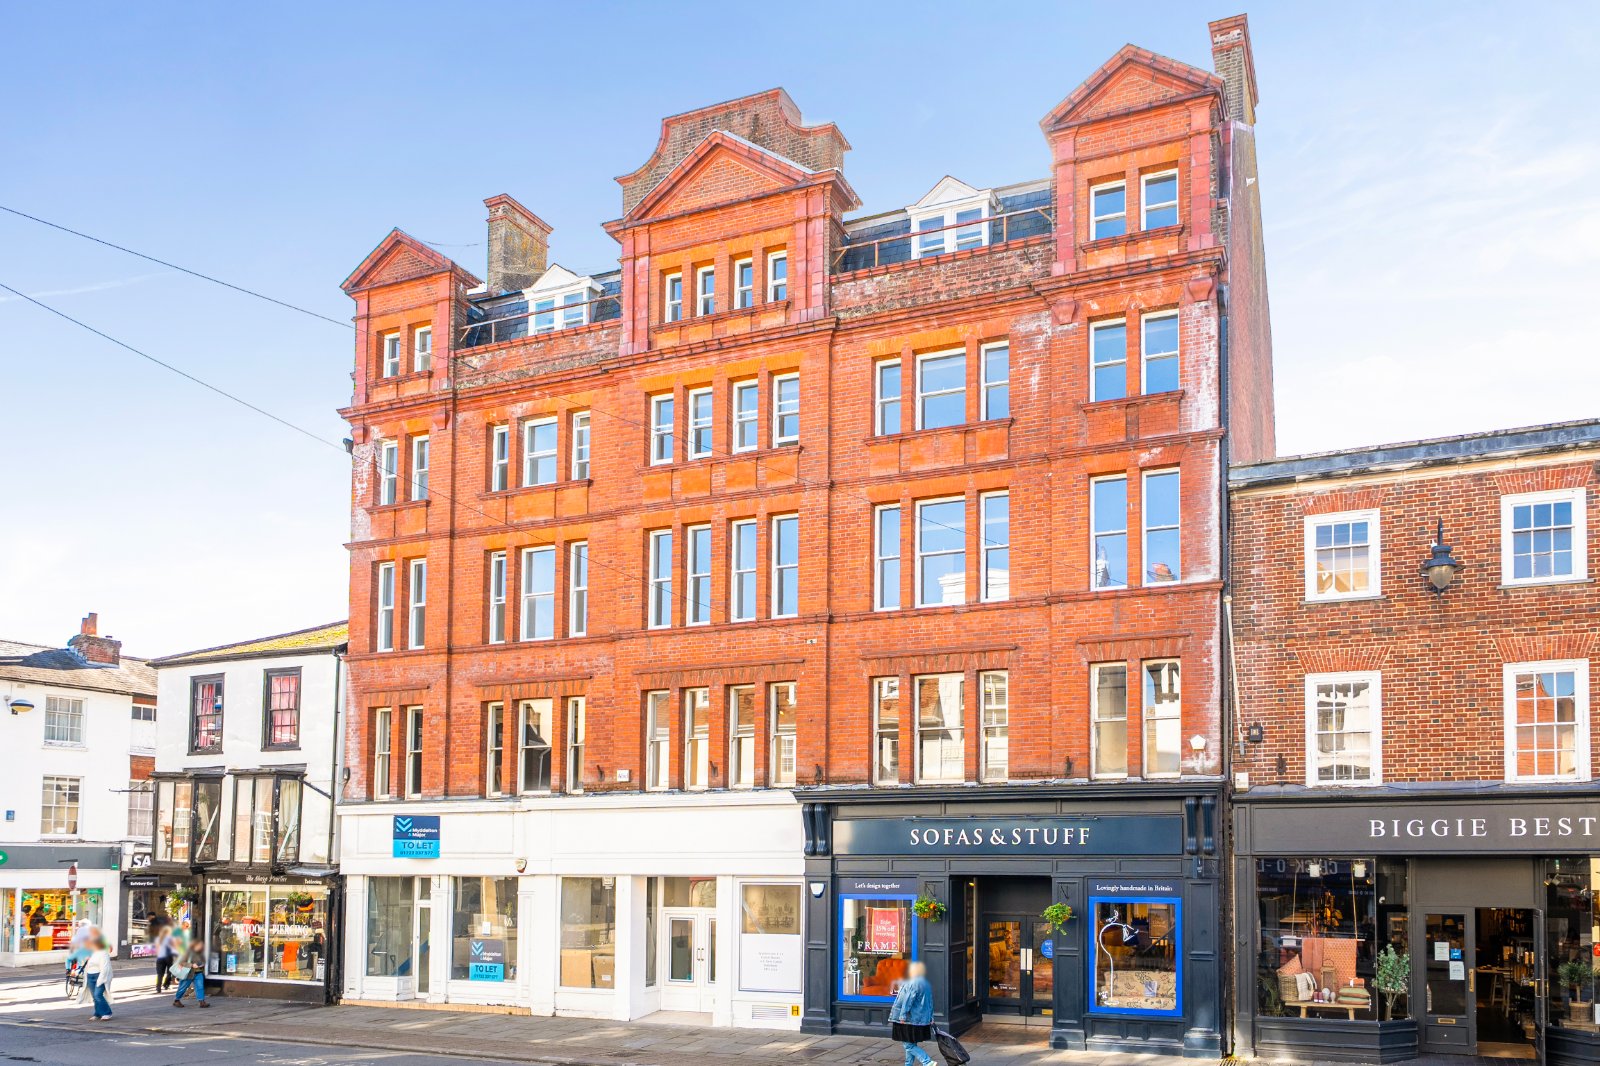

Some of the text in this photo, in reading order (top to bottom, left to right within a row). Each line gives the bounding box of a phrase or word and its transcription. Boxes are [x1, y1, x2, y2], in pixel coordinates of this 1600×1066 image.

[1368, 817, 1597, 837] BIGGIE BEST
[910, 828, 1090, 845] SOFAS & STUFF
[866, 882, 881, 890] design
[881, 882, 900, 890] together
[231, 923, 309, 936] TATTOO PIERCING
